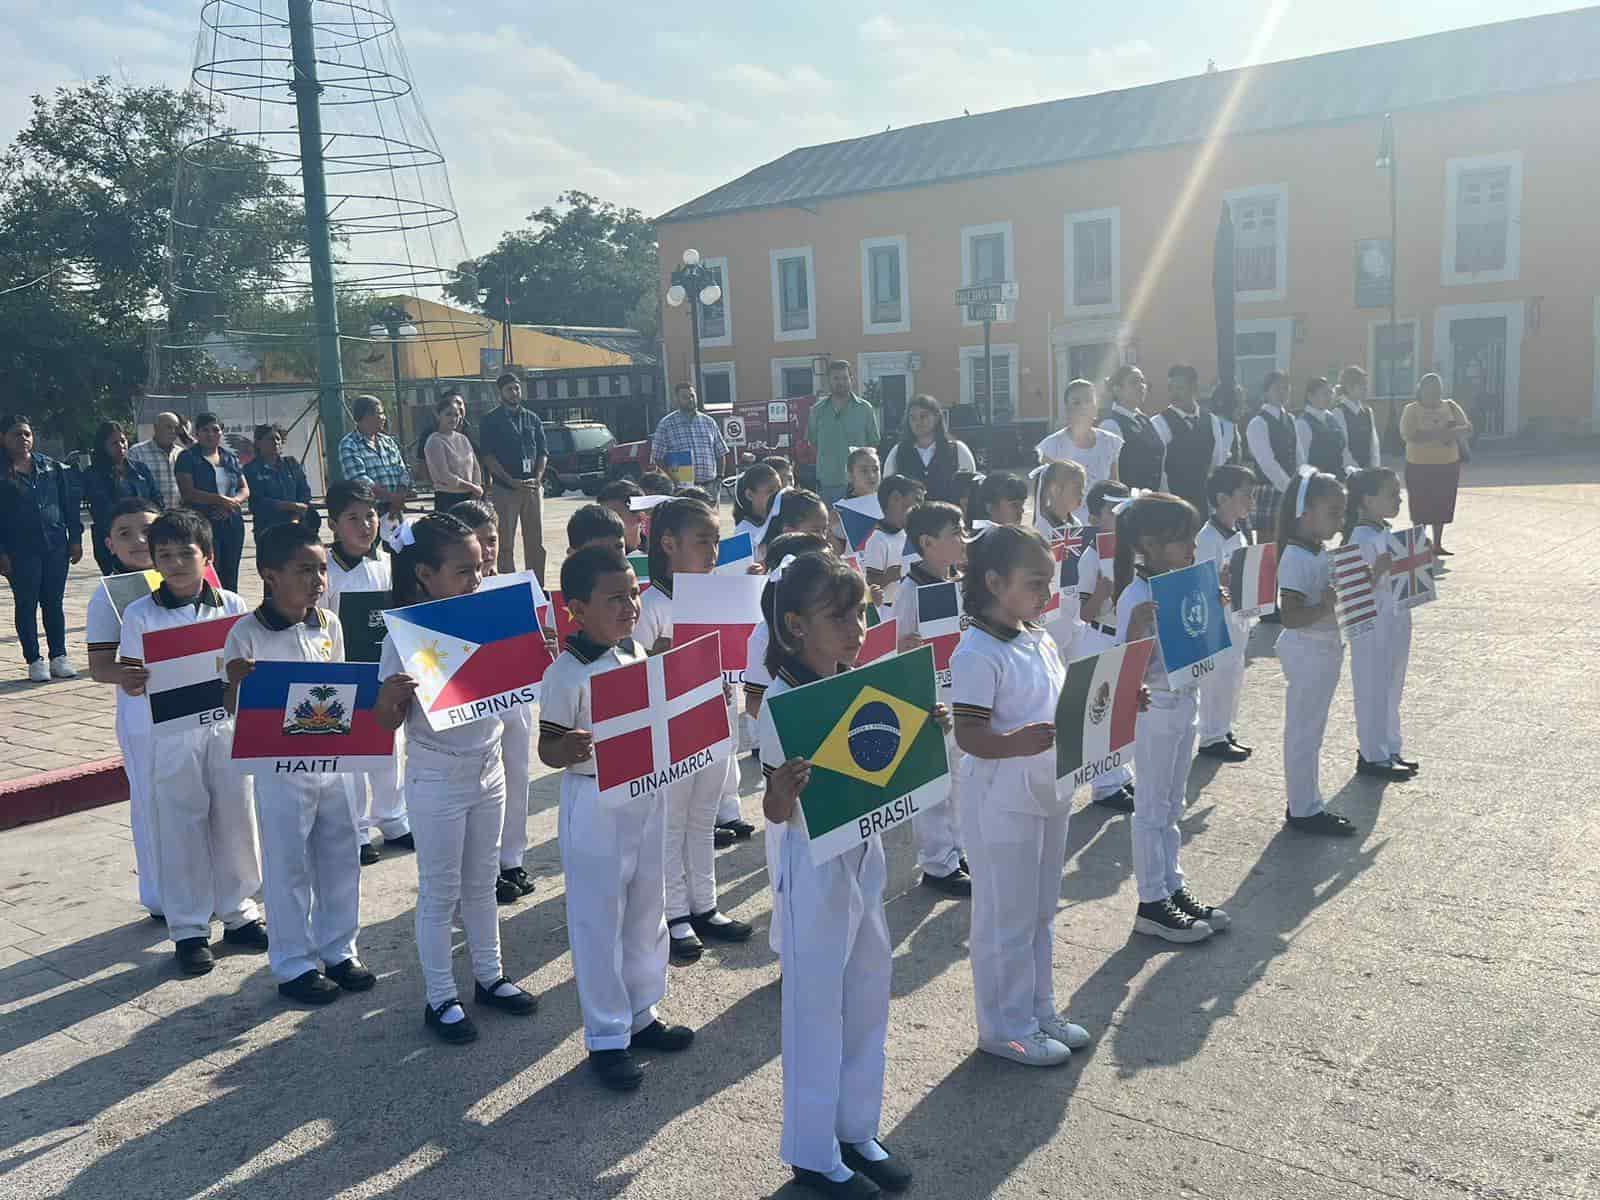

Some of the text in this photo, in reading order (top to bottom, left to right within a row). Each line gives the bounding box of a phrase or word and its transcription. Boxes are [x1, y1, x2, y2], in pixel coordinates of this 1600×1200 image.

[1191, 656, 1215, 678] ONU
[448, 687, 534, 724] FILIPINAS
[275, 756, 340, 774] HAITÍ
[629, 749, 714, 798] DINAMARCA
[1073, 752, 1120, 789] MÉXICO
[859, 795, 919, 839] BRASIL
